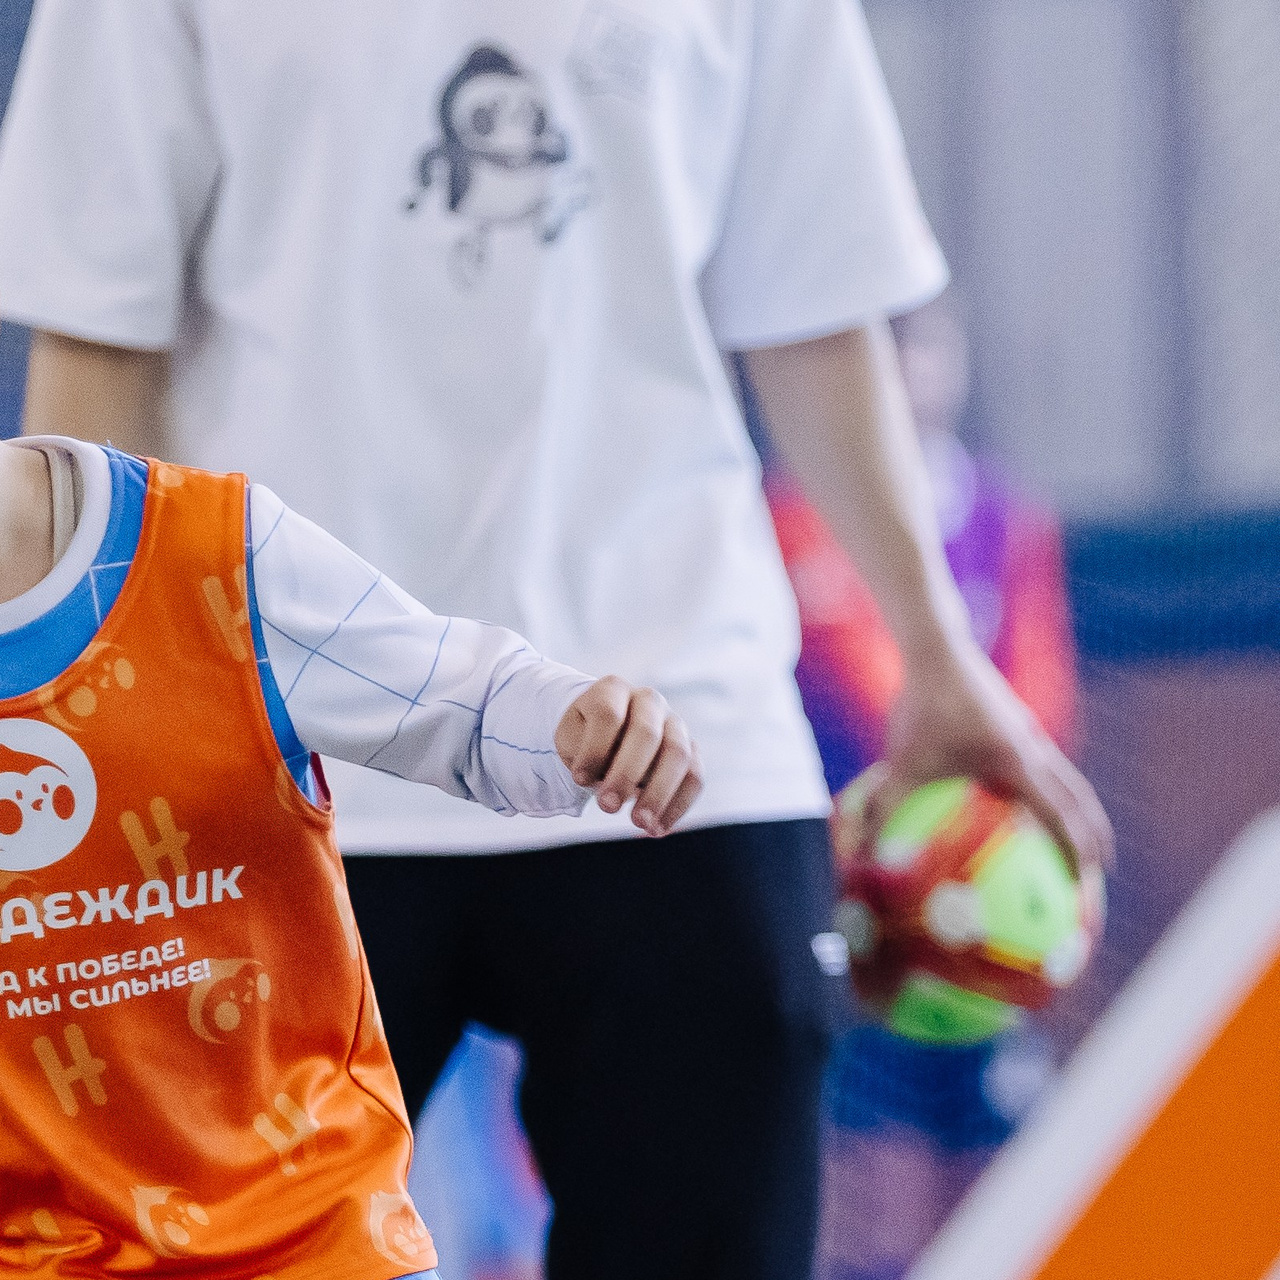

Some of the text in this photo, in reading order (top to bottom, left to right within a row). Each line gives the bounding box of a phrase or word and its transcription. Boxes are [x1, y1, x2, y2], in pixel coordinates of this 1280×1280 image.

[6, 993, 62, 1019] МЫ
[68, 958, 212, 1009] СИЛЬНЕЕ!
[27, 966, 49, 988] К
[55, 937, 186, 984] ПОБЕДЕ!
